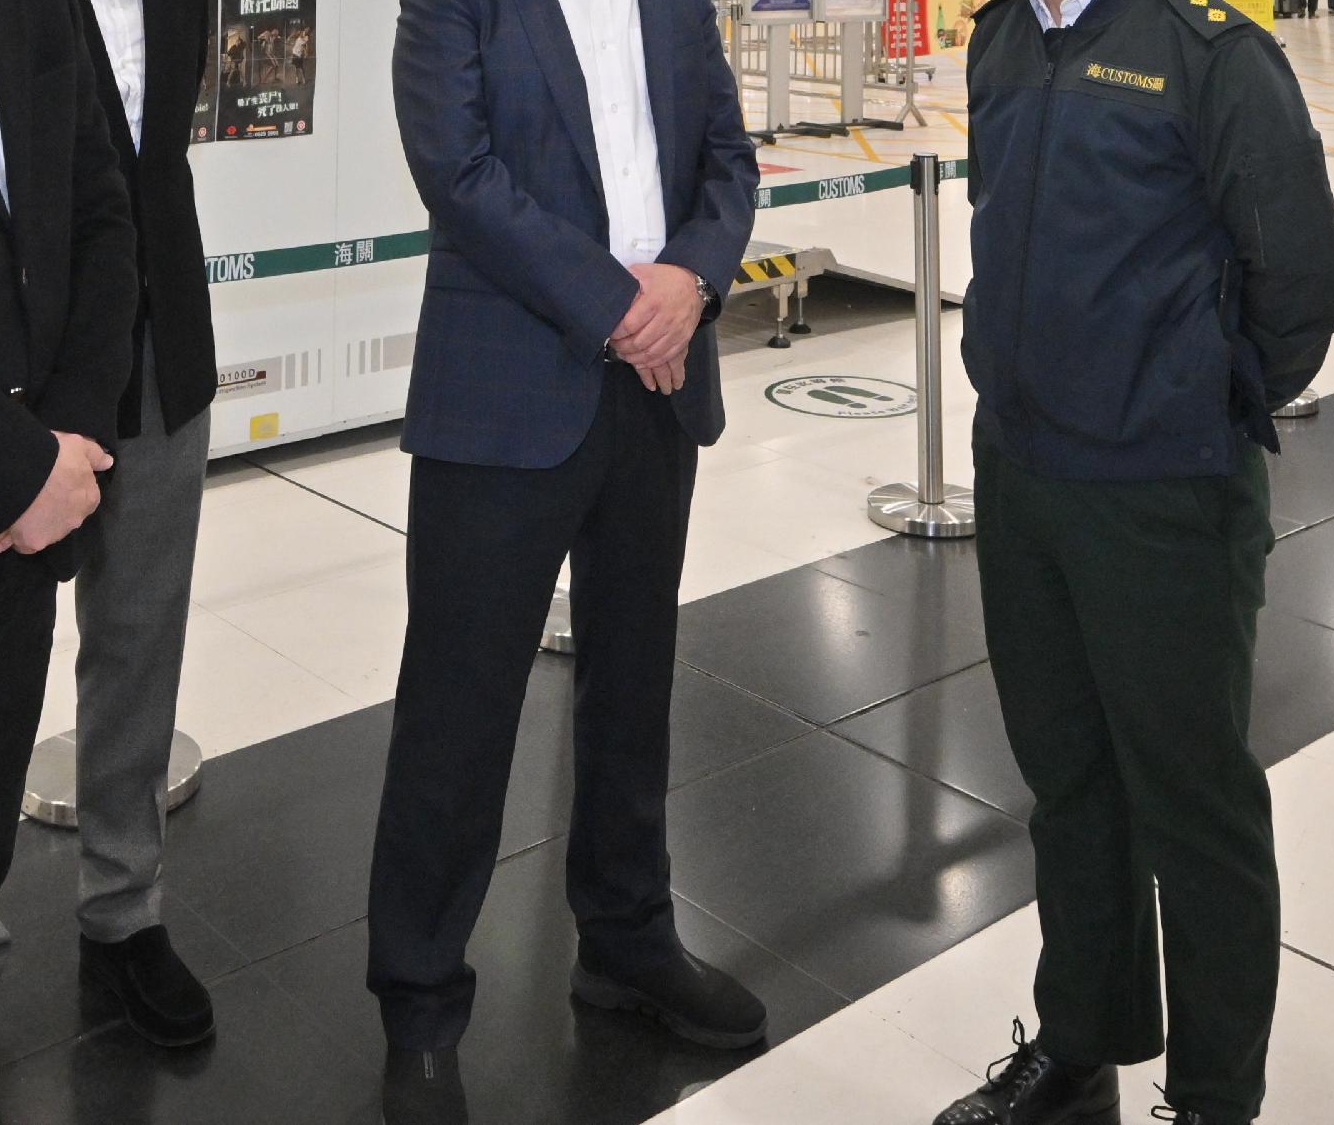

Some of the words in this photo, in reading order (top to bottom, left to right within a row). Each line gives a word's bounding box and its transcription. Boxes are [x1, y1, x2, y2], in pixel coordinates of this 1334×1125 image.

[818, 174, 865, 201] CUSTOMS
[334, 238, 374, 267] 海關
[205, 252, 255, 284] TOMS
